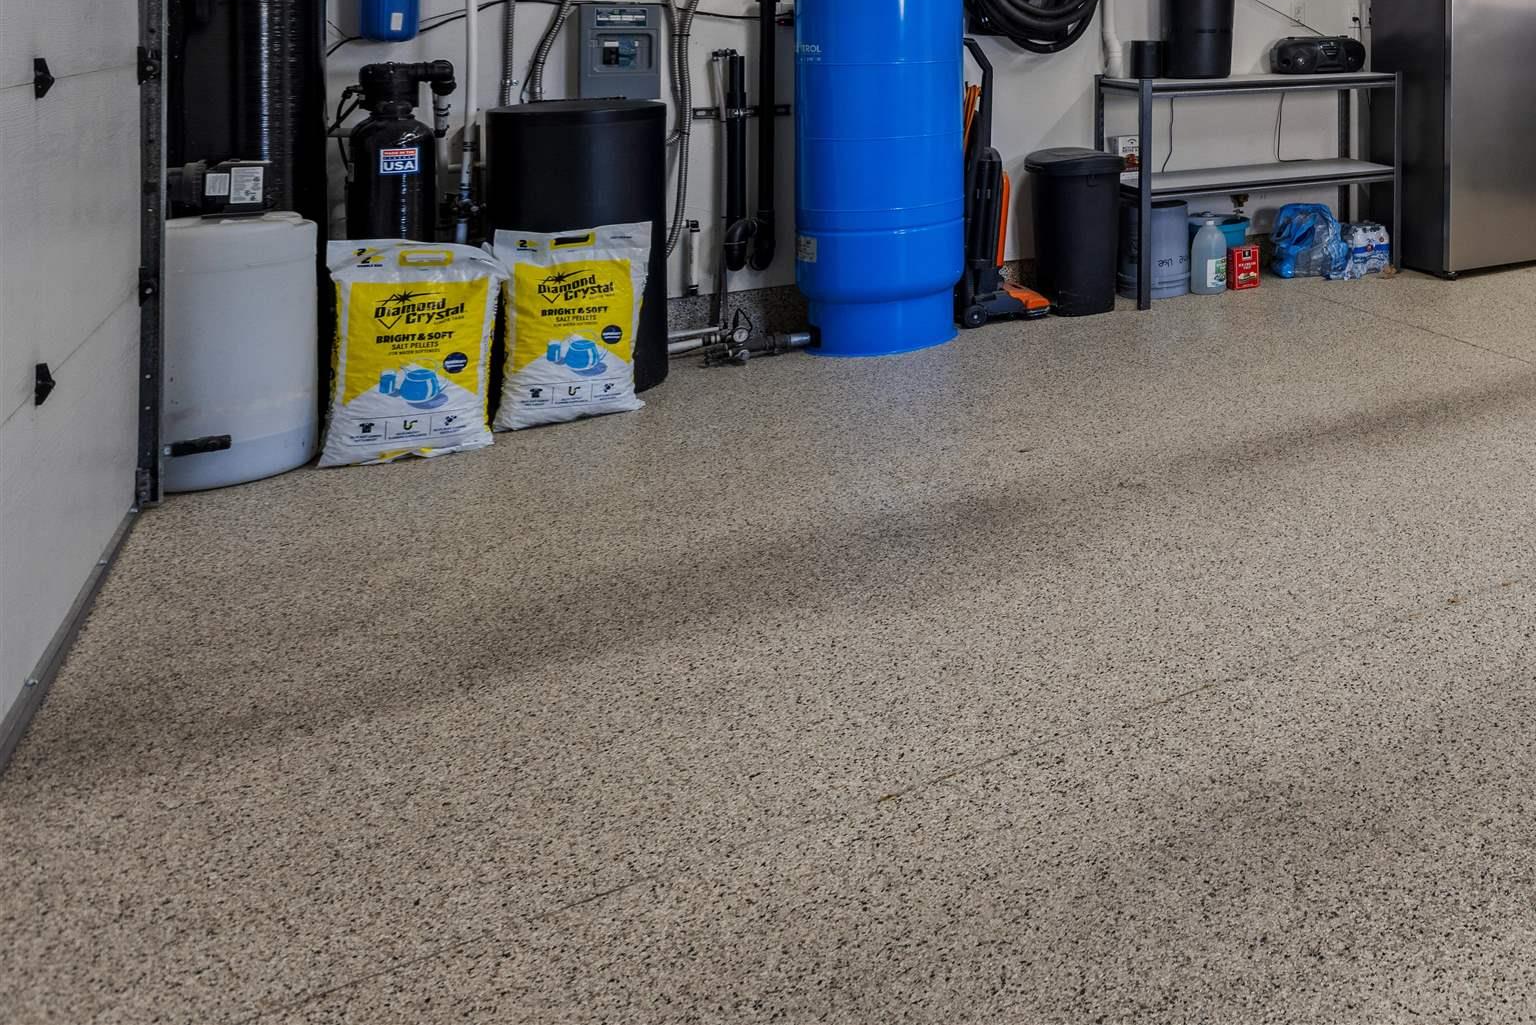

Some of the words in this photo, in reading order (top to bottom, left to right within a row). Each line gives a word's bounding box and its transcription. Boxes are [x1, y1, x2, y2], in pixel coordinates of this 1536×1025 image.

[384, 160, 415, 171] USA
[519, 239, 528, 248] 2
[538, 274, 596, 294] Diamond
[564, 282, 614, 302] Crystal
[374, 298, 447, 319] Diamond
[405, 303, 465, 325] Crystal
[541, 307, 576, 317] BRIGHT
[586, 306, 608, 314] SOFT
[376, 332, 417, 344] BRIGHT
[417, 332, 426, 340] &
[427, 331, 454, 340] SOFT
[392, 343, 408, 351] SALT
[410, 341, 438, 349] PELLETS
